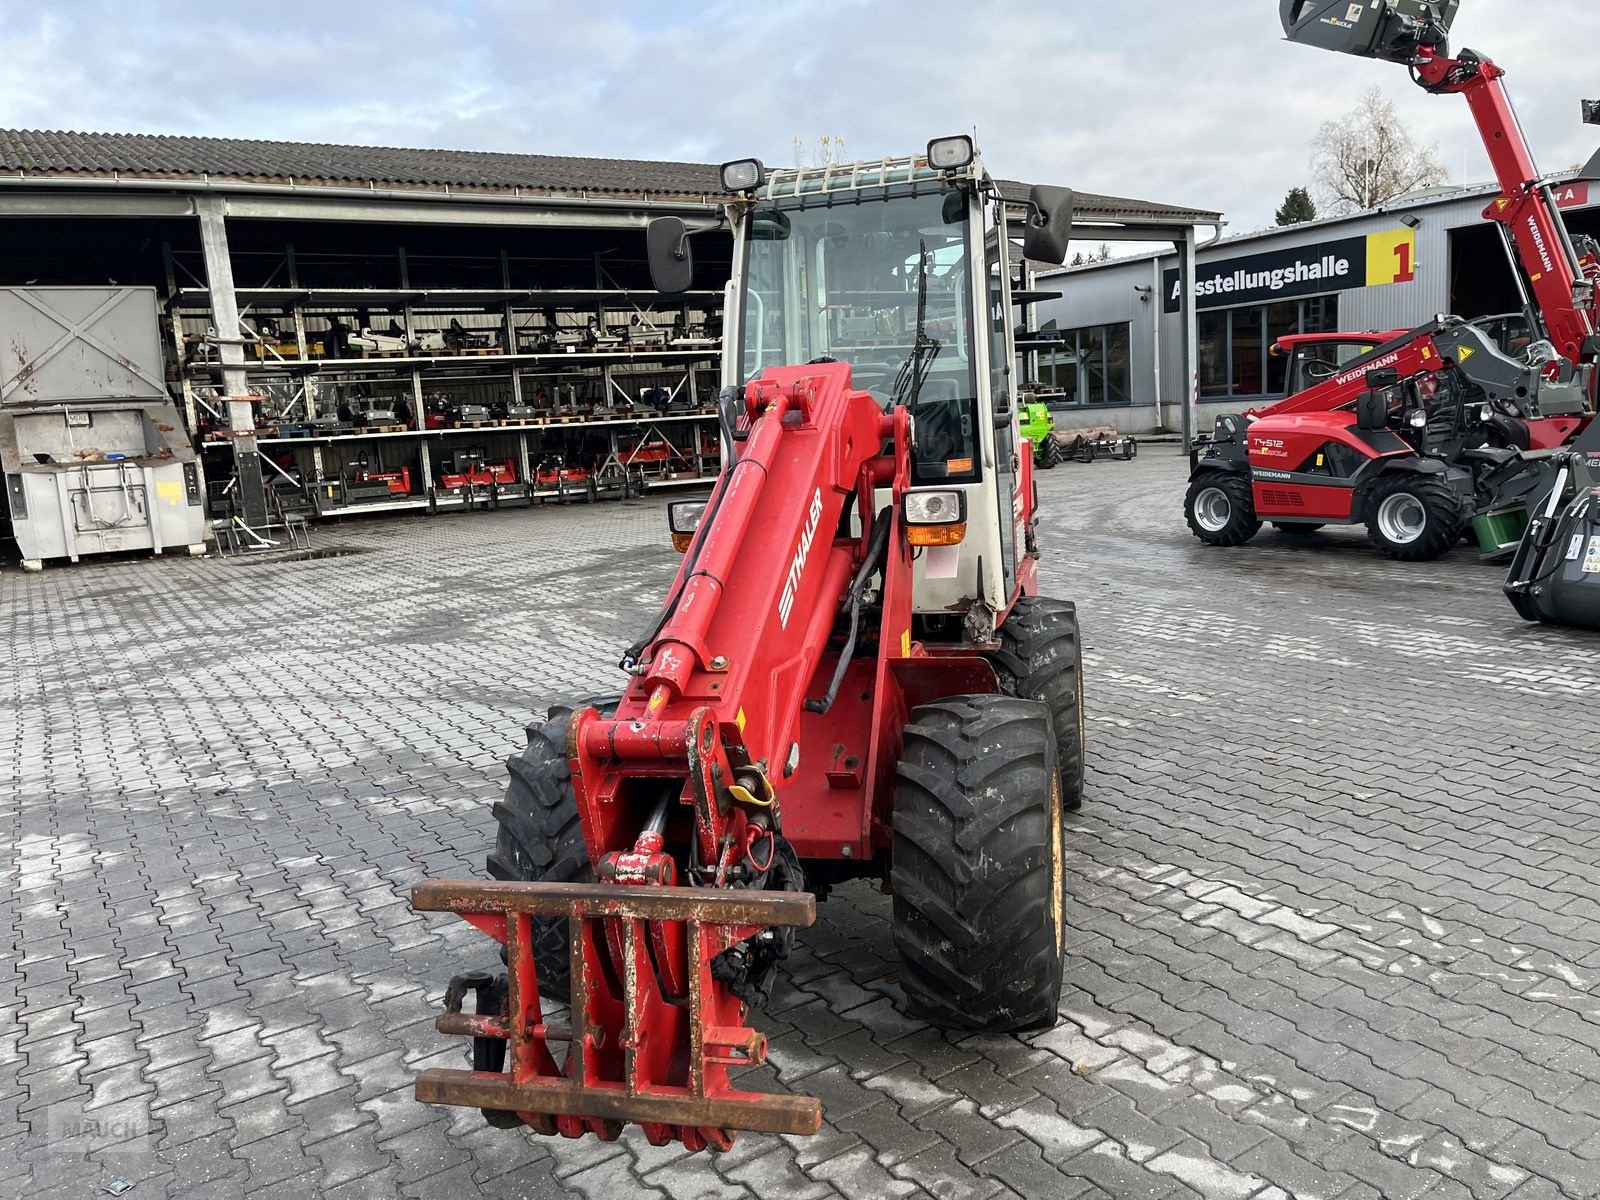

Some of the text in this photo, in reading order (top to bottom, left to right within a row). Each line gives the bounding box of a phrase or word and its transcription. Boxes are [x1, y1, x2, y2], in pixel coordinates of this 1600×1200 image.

[1565, 188, 1575, 200] A
[1527, 214, 1554, 272] WEIDEMANN
[1171, 242, 1414, 300] Asstellungshalle 1
[1254, 438, 1284, 448] T4512
[1253, 470, 1291, 480] WEIDEMANN
[787, 488, 823, 592] THALER
